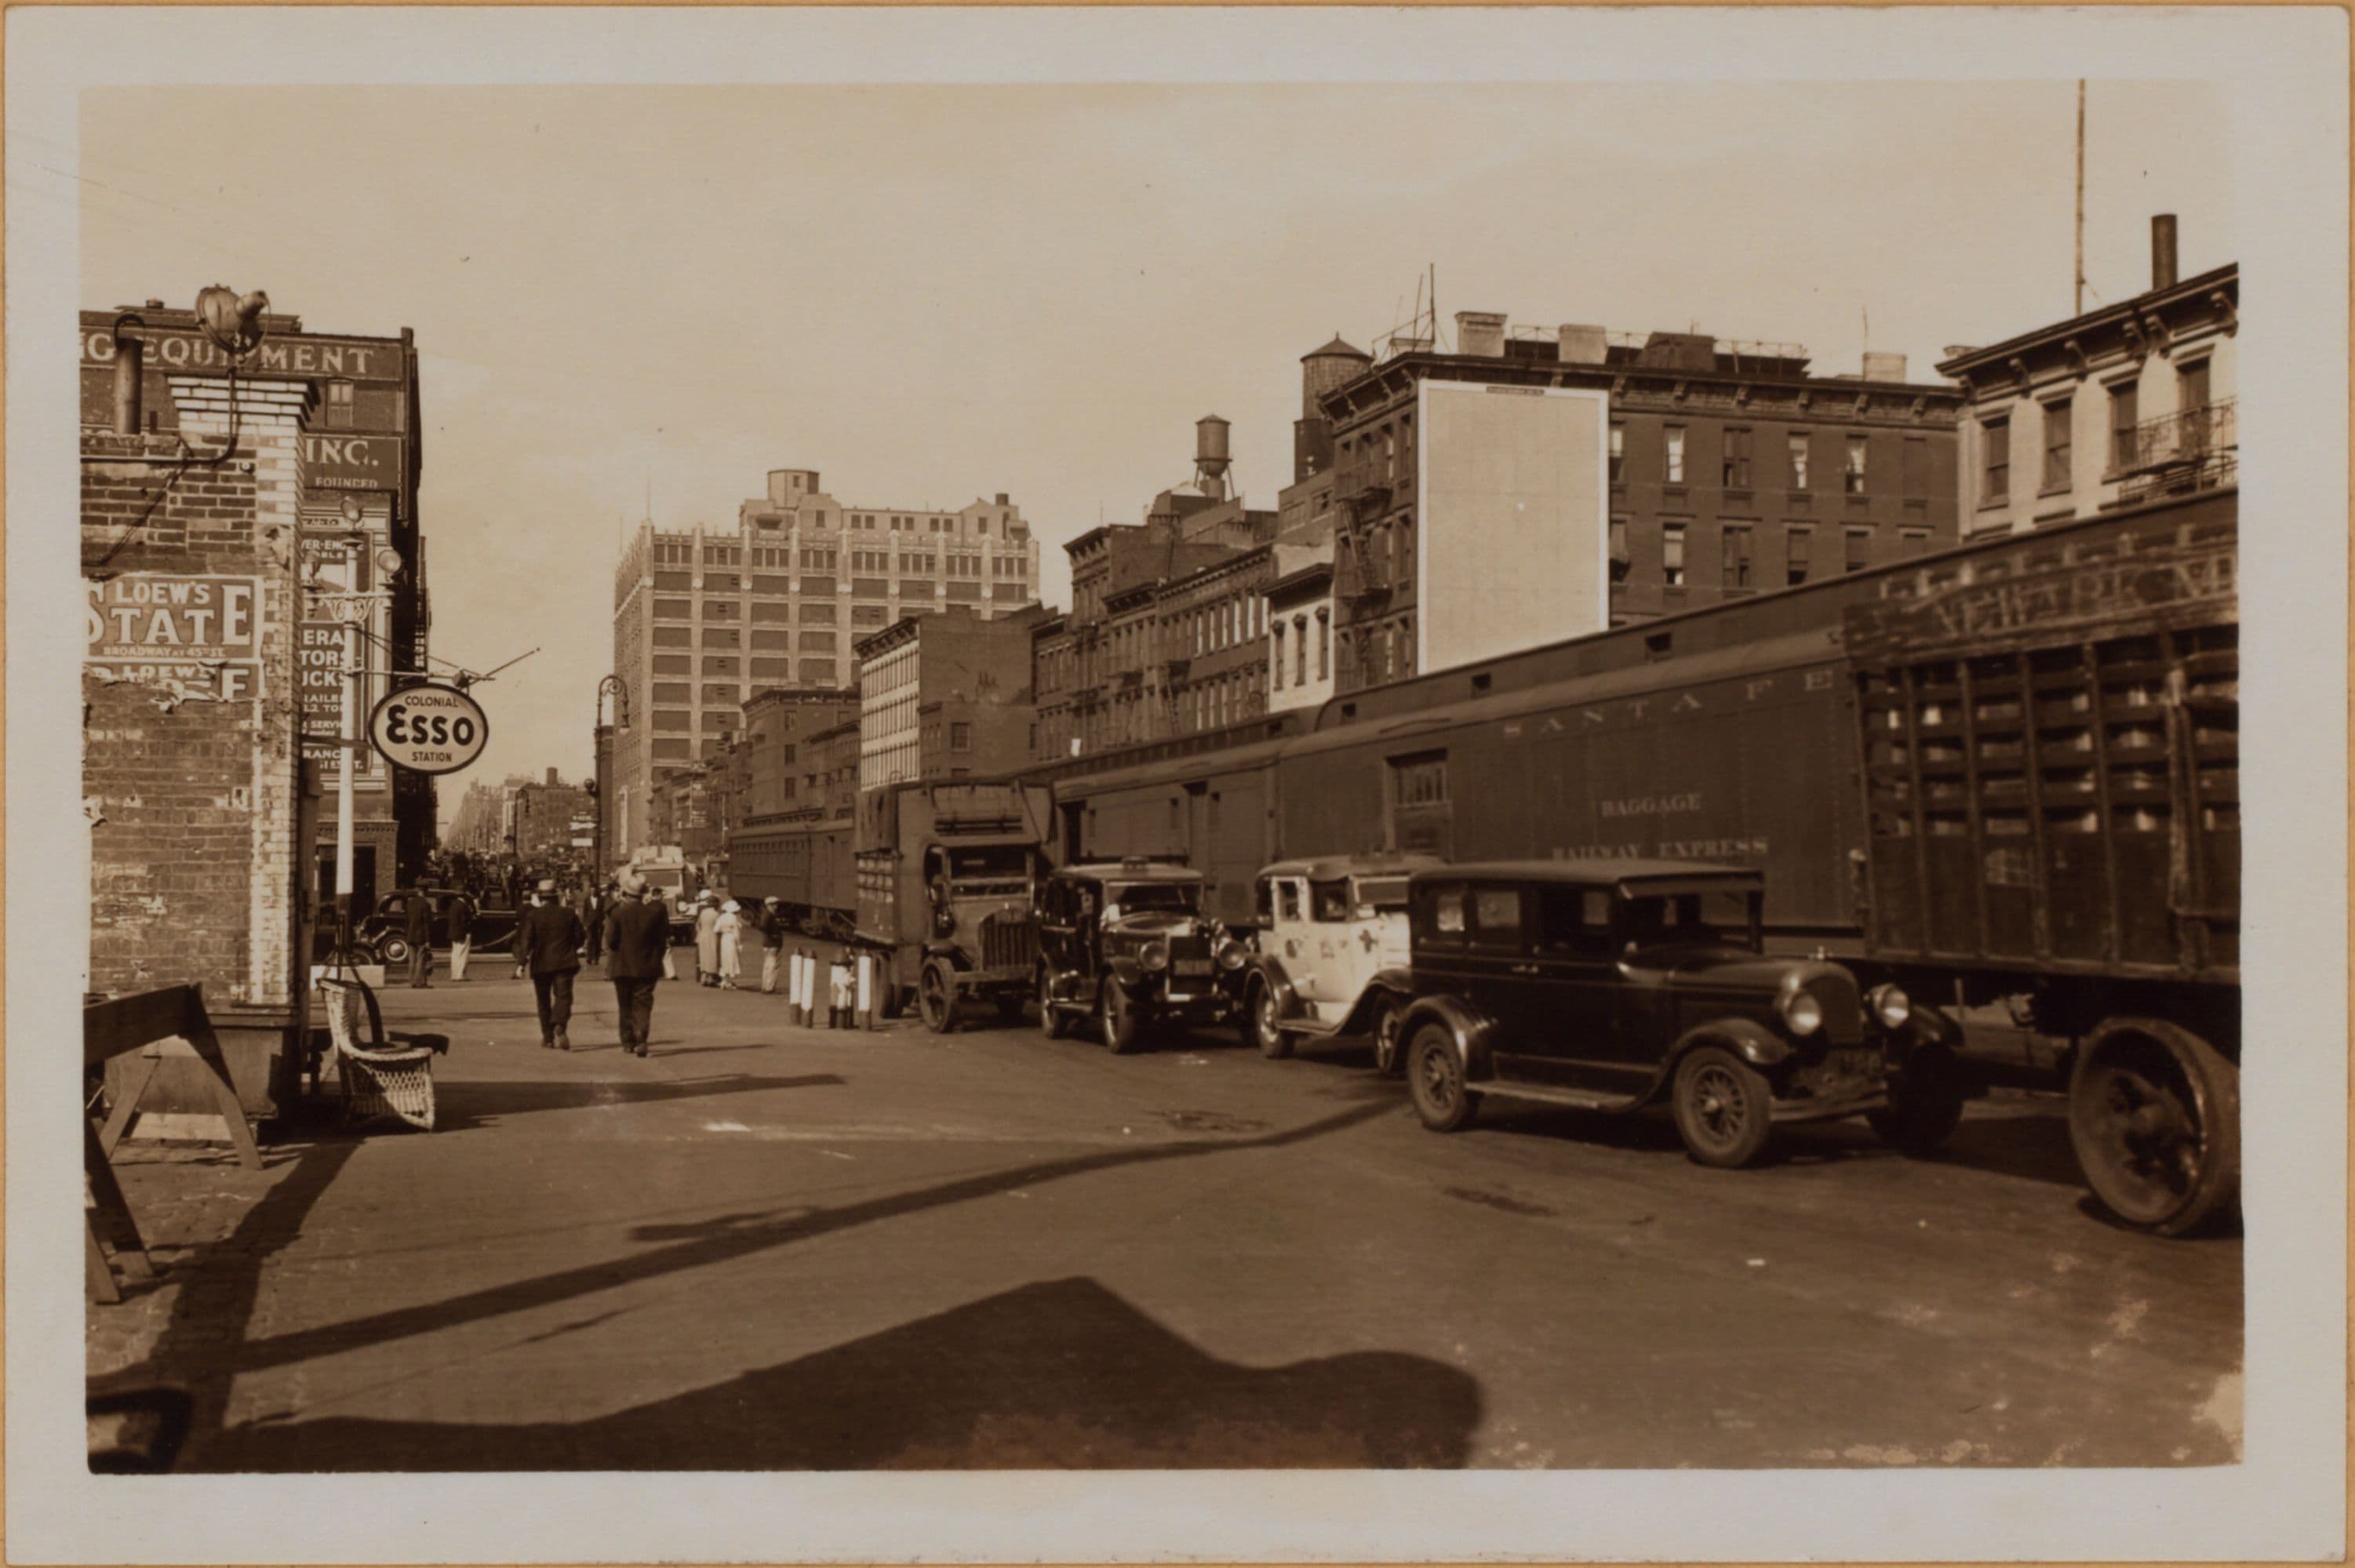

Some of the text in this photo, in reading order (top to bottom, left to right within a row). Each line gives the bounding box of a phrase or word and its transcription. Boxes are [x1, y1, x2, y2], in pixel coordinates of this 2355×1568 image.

[142, 336, 375, 373] EQUIMENT
[306, 438, 380, 467] INC.
[115, 580, 210, 605] LOEW'S
[103, 646, 171, 657] BROADWAY
[405, 696, 458, 708] COLONIAL
[1504, 669, 1833, 734] SANTA FE
[412, 751, 453, 762] STATION
[1600, 791, 1702, 818] BAGGAGE
[1552, 837, 1768, 860] RAILWAY EXPRESS
